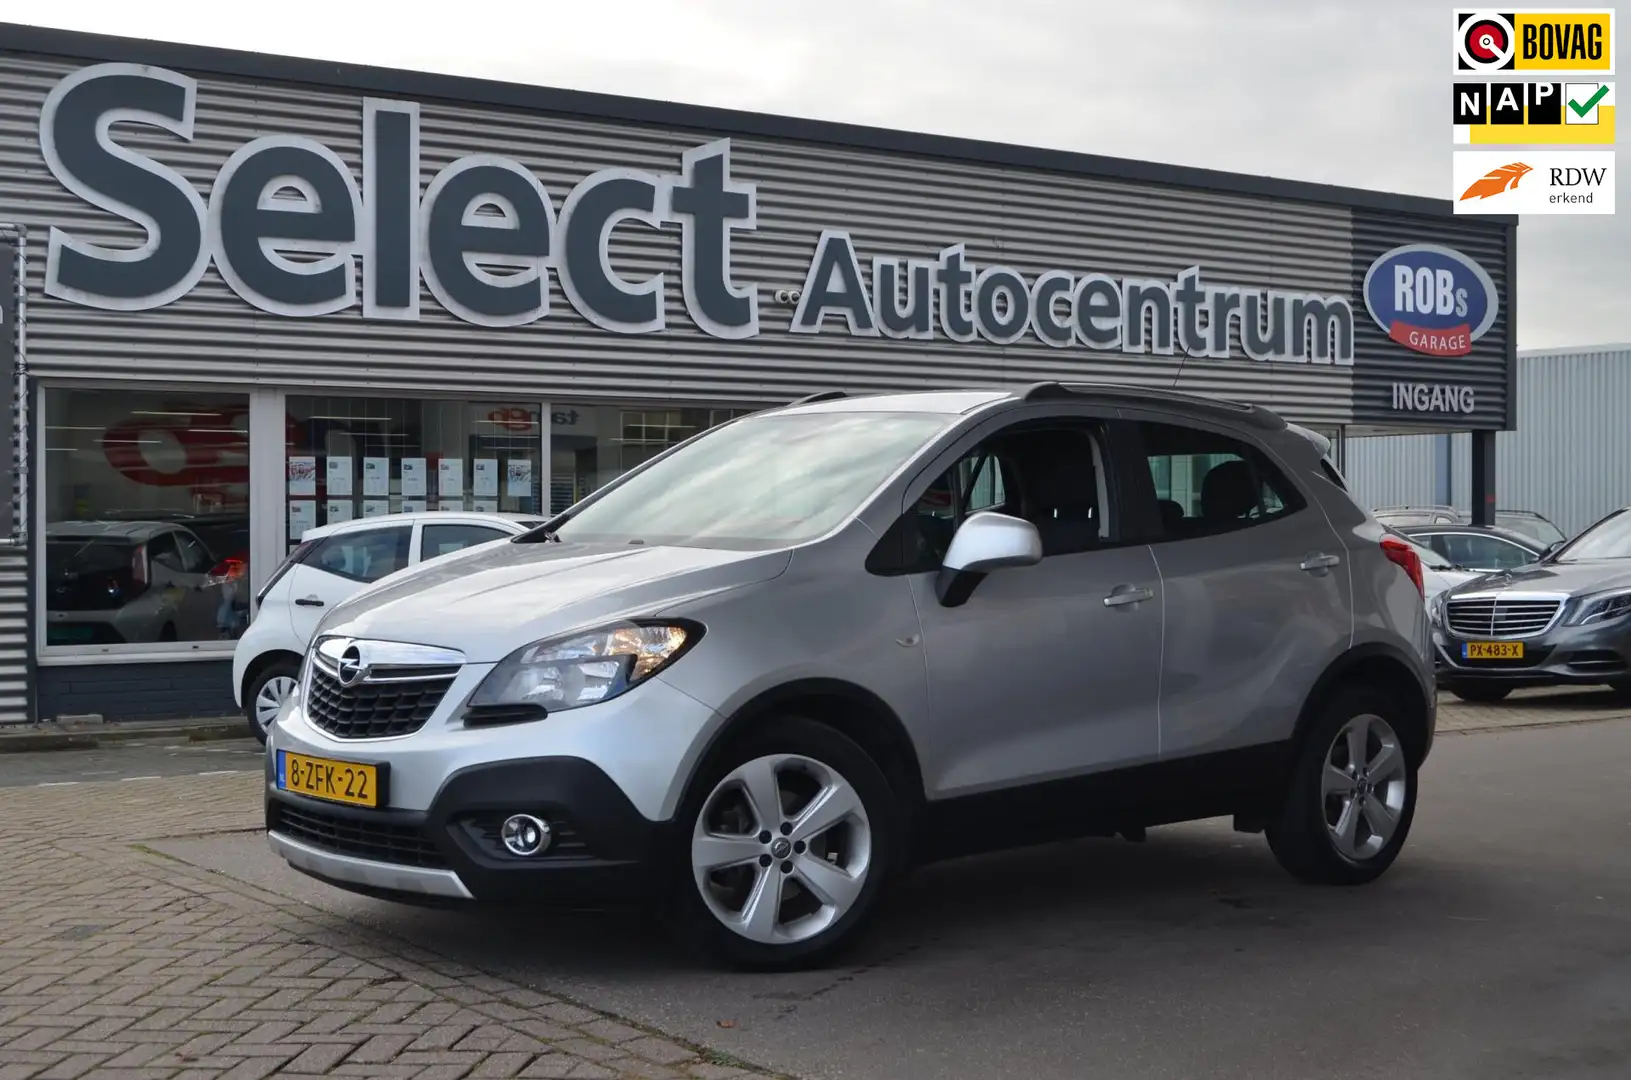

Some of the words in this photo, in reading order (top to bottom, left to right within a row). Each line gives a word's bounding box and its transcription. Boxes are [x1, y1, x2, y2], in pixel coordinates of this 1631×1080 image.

[39, 62, 759, 340] Select
[789, 229, 1354, 366] Autocentrum
[1394, 264, 1468, 318] ROBs
[1409, 331, 1466, 350] GARAGE
[1392, 382, 1475, 413] INGANG
[1470, 644, 1519, 657] PX-483-X
[291, 759, 368, 799] 8-ZFK-22
